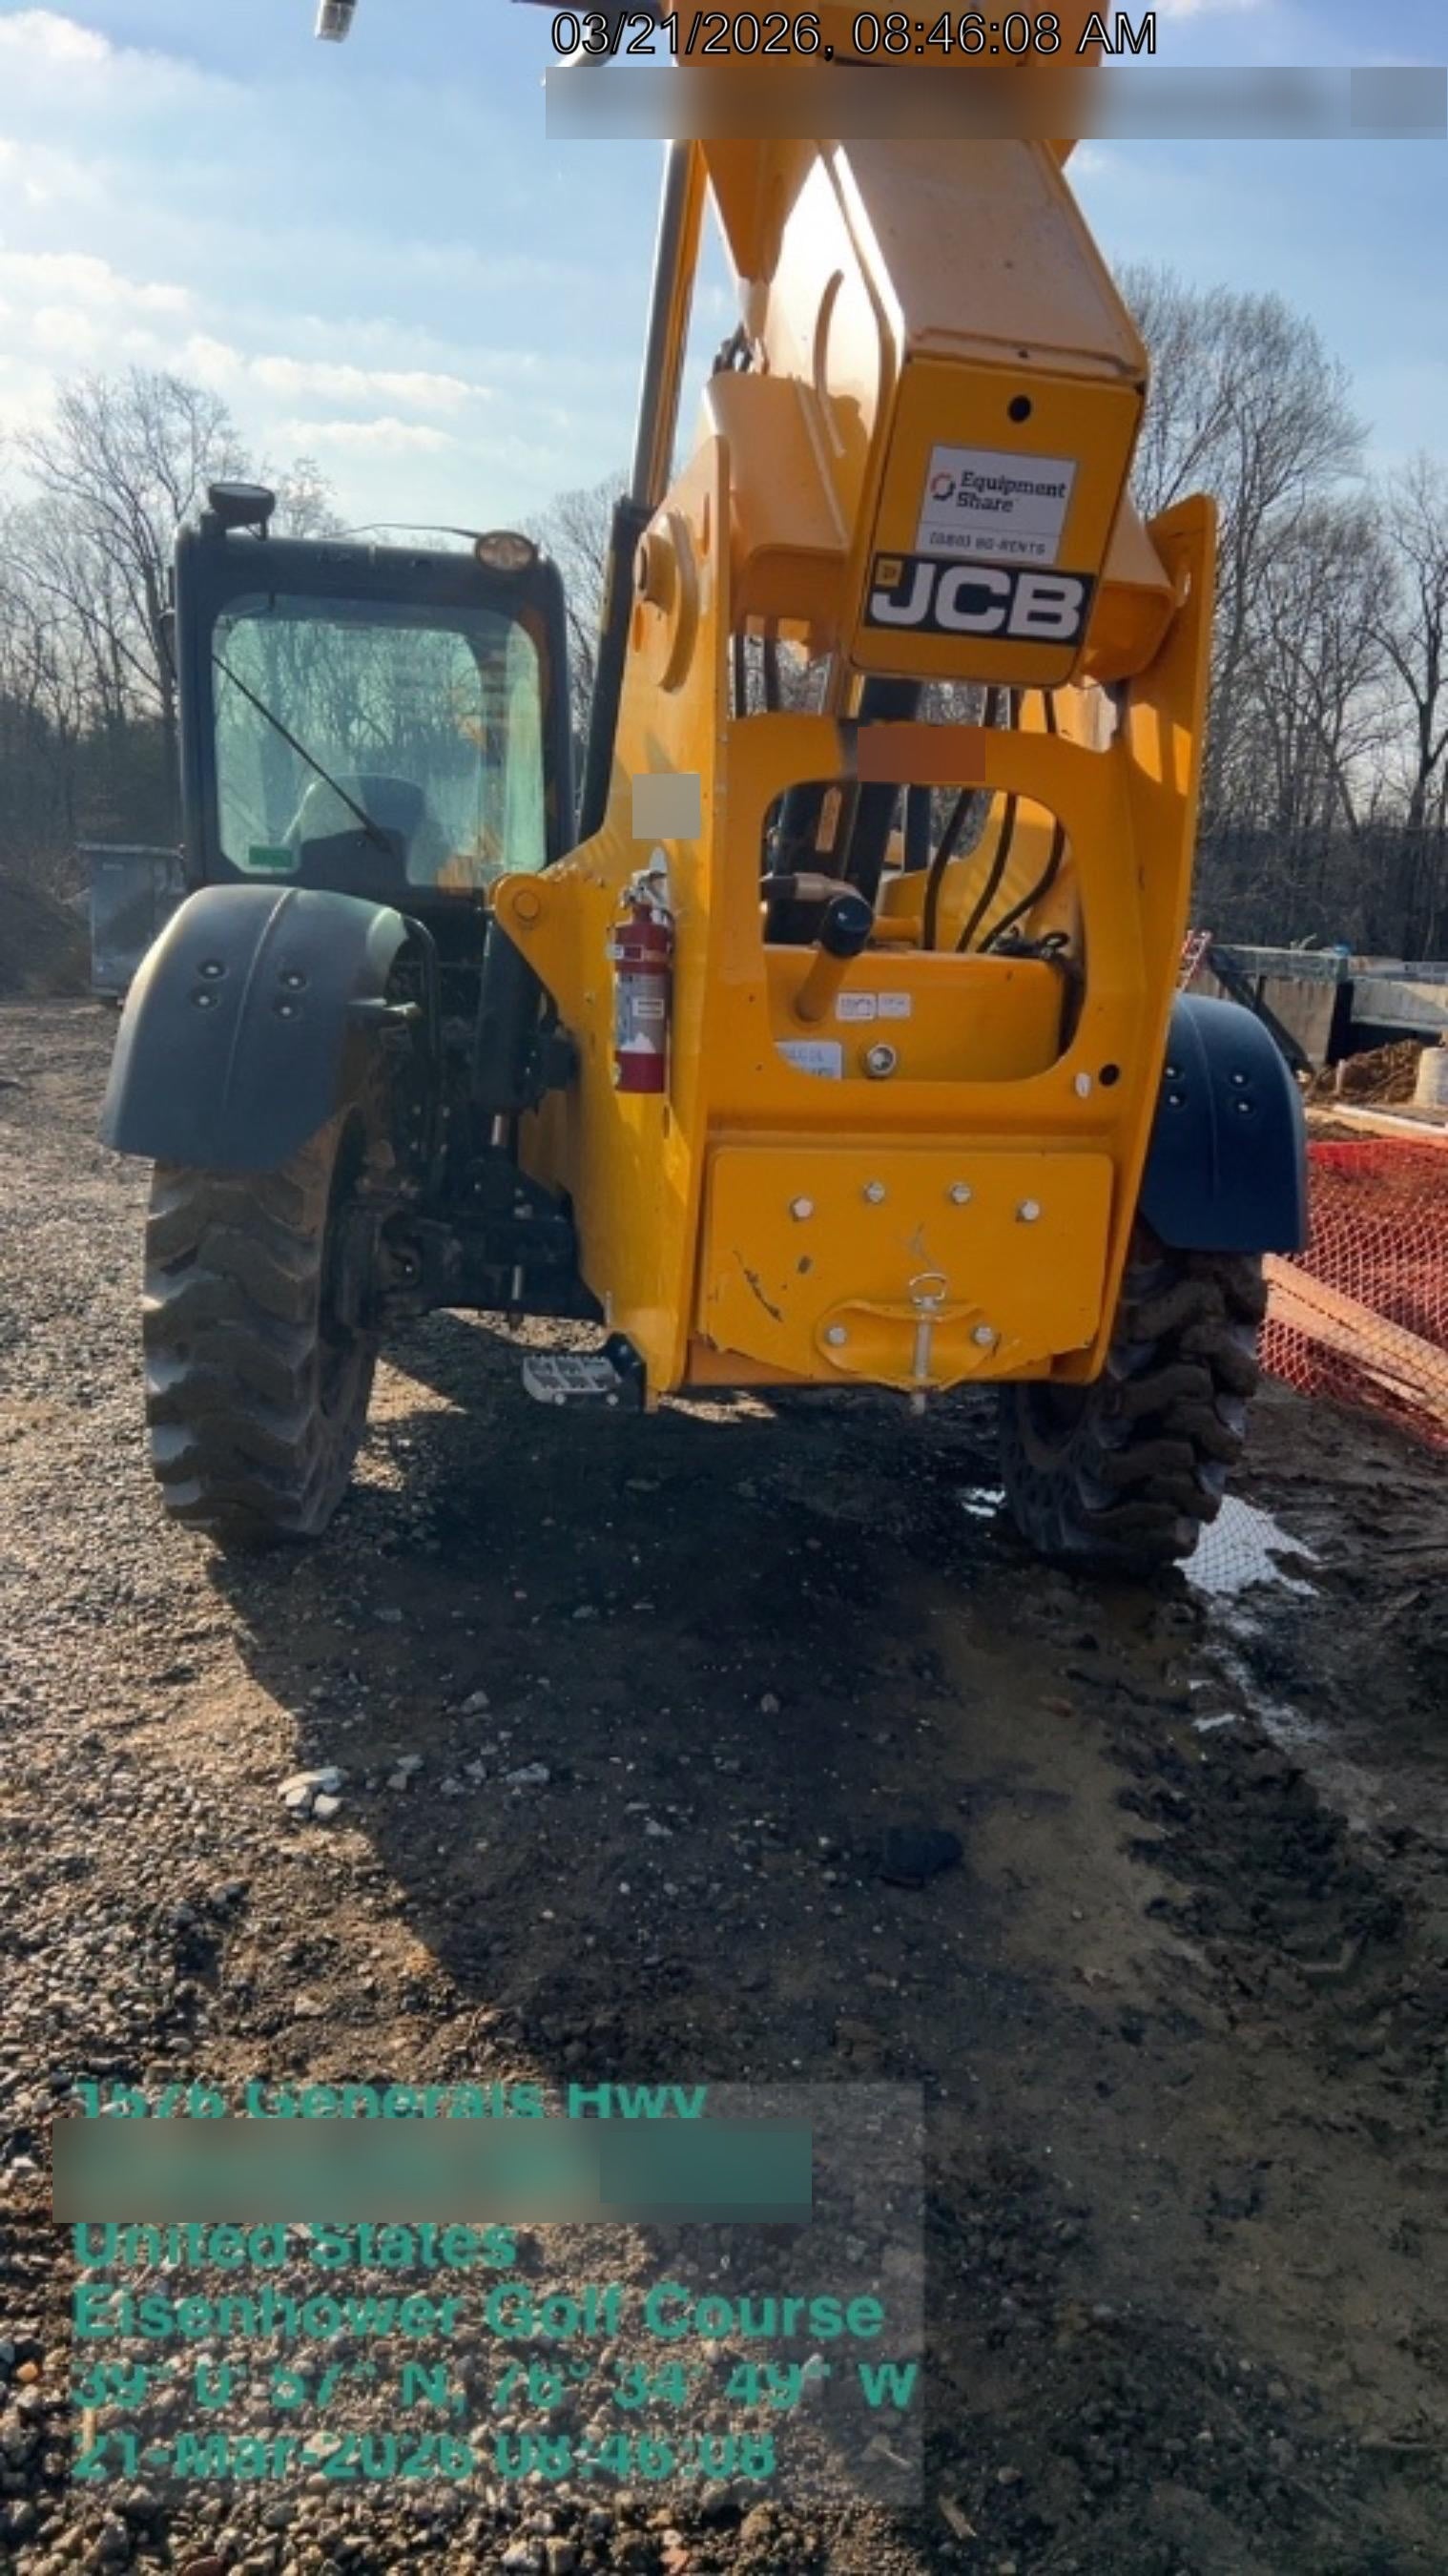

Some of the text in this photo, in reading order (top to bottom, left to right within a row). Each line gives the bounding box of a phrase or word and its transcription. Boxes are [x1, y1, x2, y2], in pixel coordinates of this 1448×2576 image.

[961, 470, 1066, 498] Equipment
[956, 491, 1013, 512] Share
[870, 562, 1085, 639] JCB
